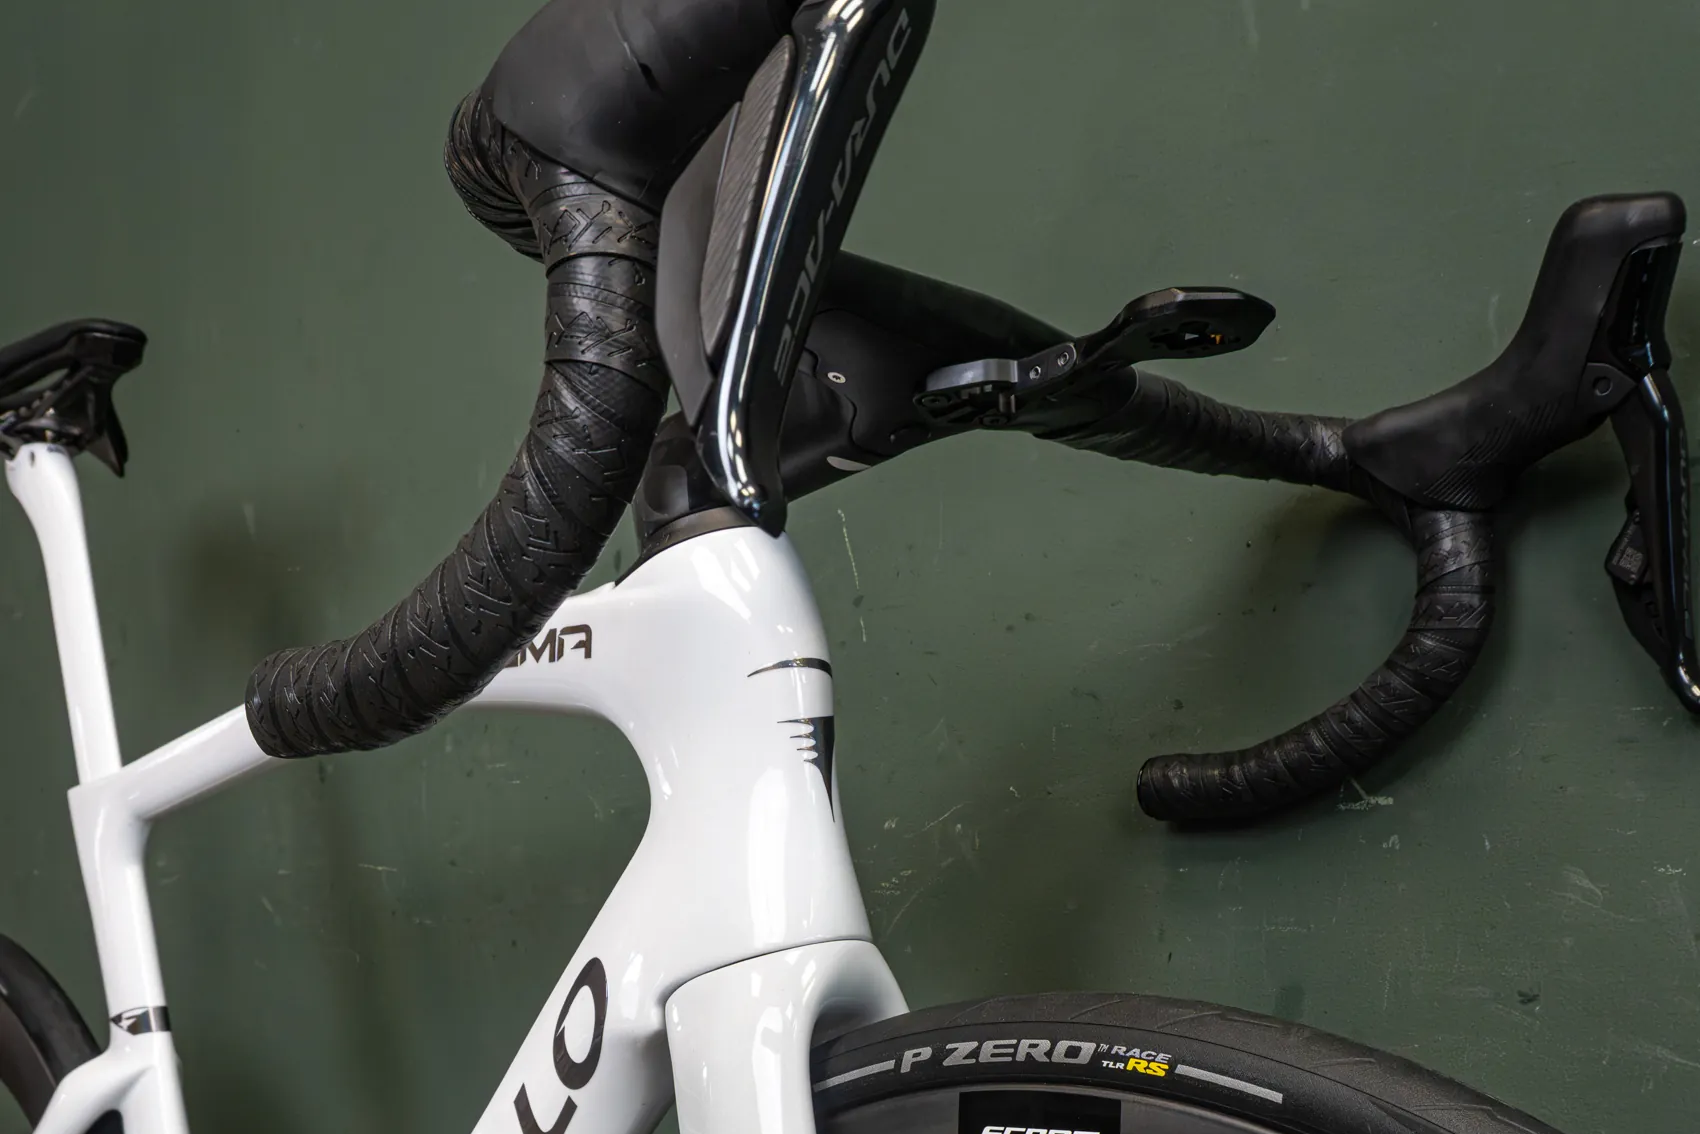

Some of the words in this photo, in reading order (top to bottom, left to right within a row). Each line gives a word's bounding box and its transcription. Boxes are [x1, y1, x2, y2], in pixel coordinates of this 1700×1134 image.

[900, 1046, 932, 1073] P
[942, 1039, 1097, 1067] ZERO
[1110, 1045, 1172, 1063] RACE
[1101, 1060, 1125, 1070] TLR
[1126, 1057, 1169, 1077] RS
